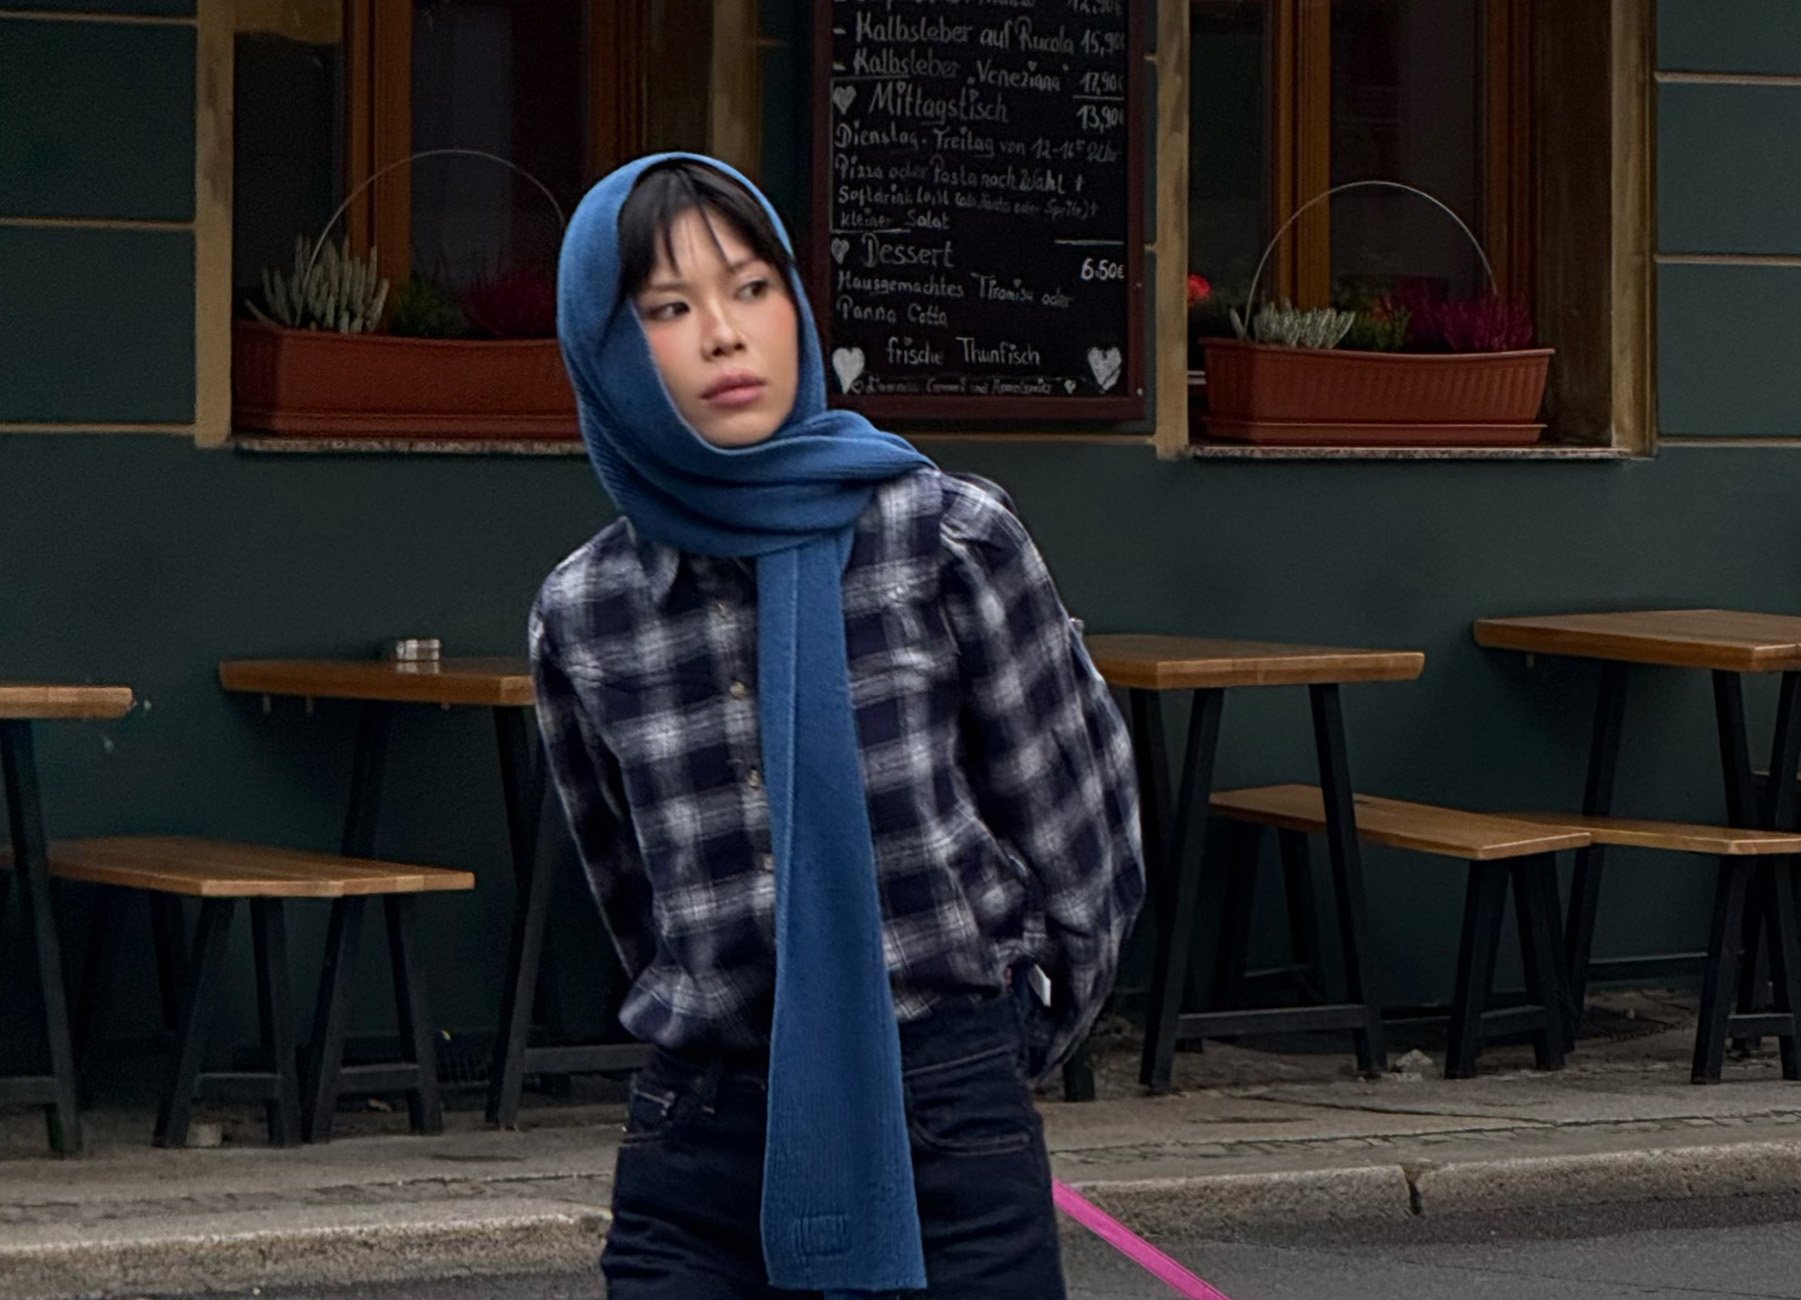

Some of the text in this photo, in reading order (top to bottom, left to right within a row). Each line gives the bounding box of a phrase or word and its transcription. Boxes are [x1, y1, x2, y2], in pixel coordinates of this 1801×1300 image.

[856, 11, 973, 43] Kalbsleber
[980, 20, 1013, 49] auf
[1015, 16, 1074, 54] Rucola
[853, 48, 961, 77] Kalbsleber
[869, 80, 1009, 125] Mittagstisch
[933, 126, 995, 158] Freitag
[835, 153, 883, 179] Pizza
[929, 154, 977, 187] Pasta
[904, 208, 949, 229] Salat
[861, 233, 954, 267] Dessert
[837, 270, 964, 298] Hausgemachtes
[837, 295, 948, 327] Panna Cotta
[885, 336, 1040, 366] frische Thunfisch
